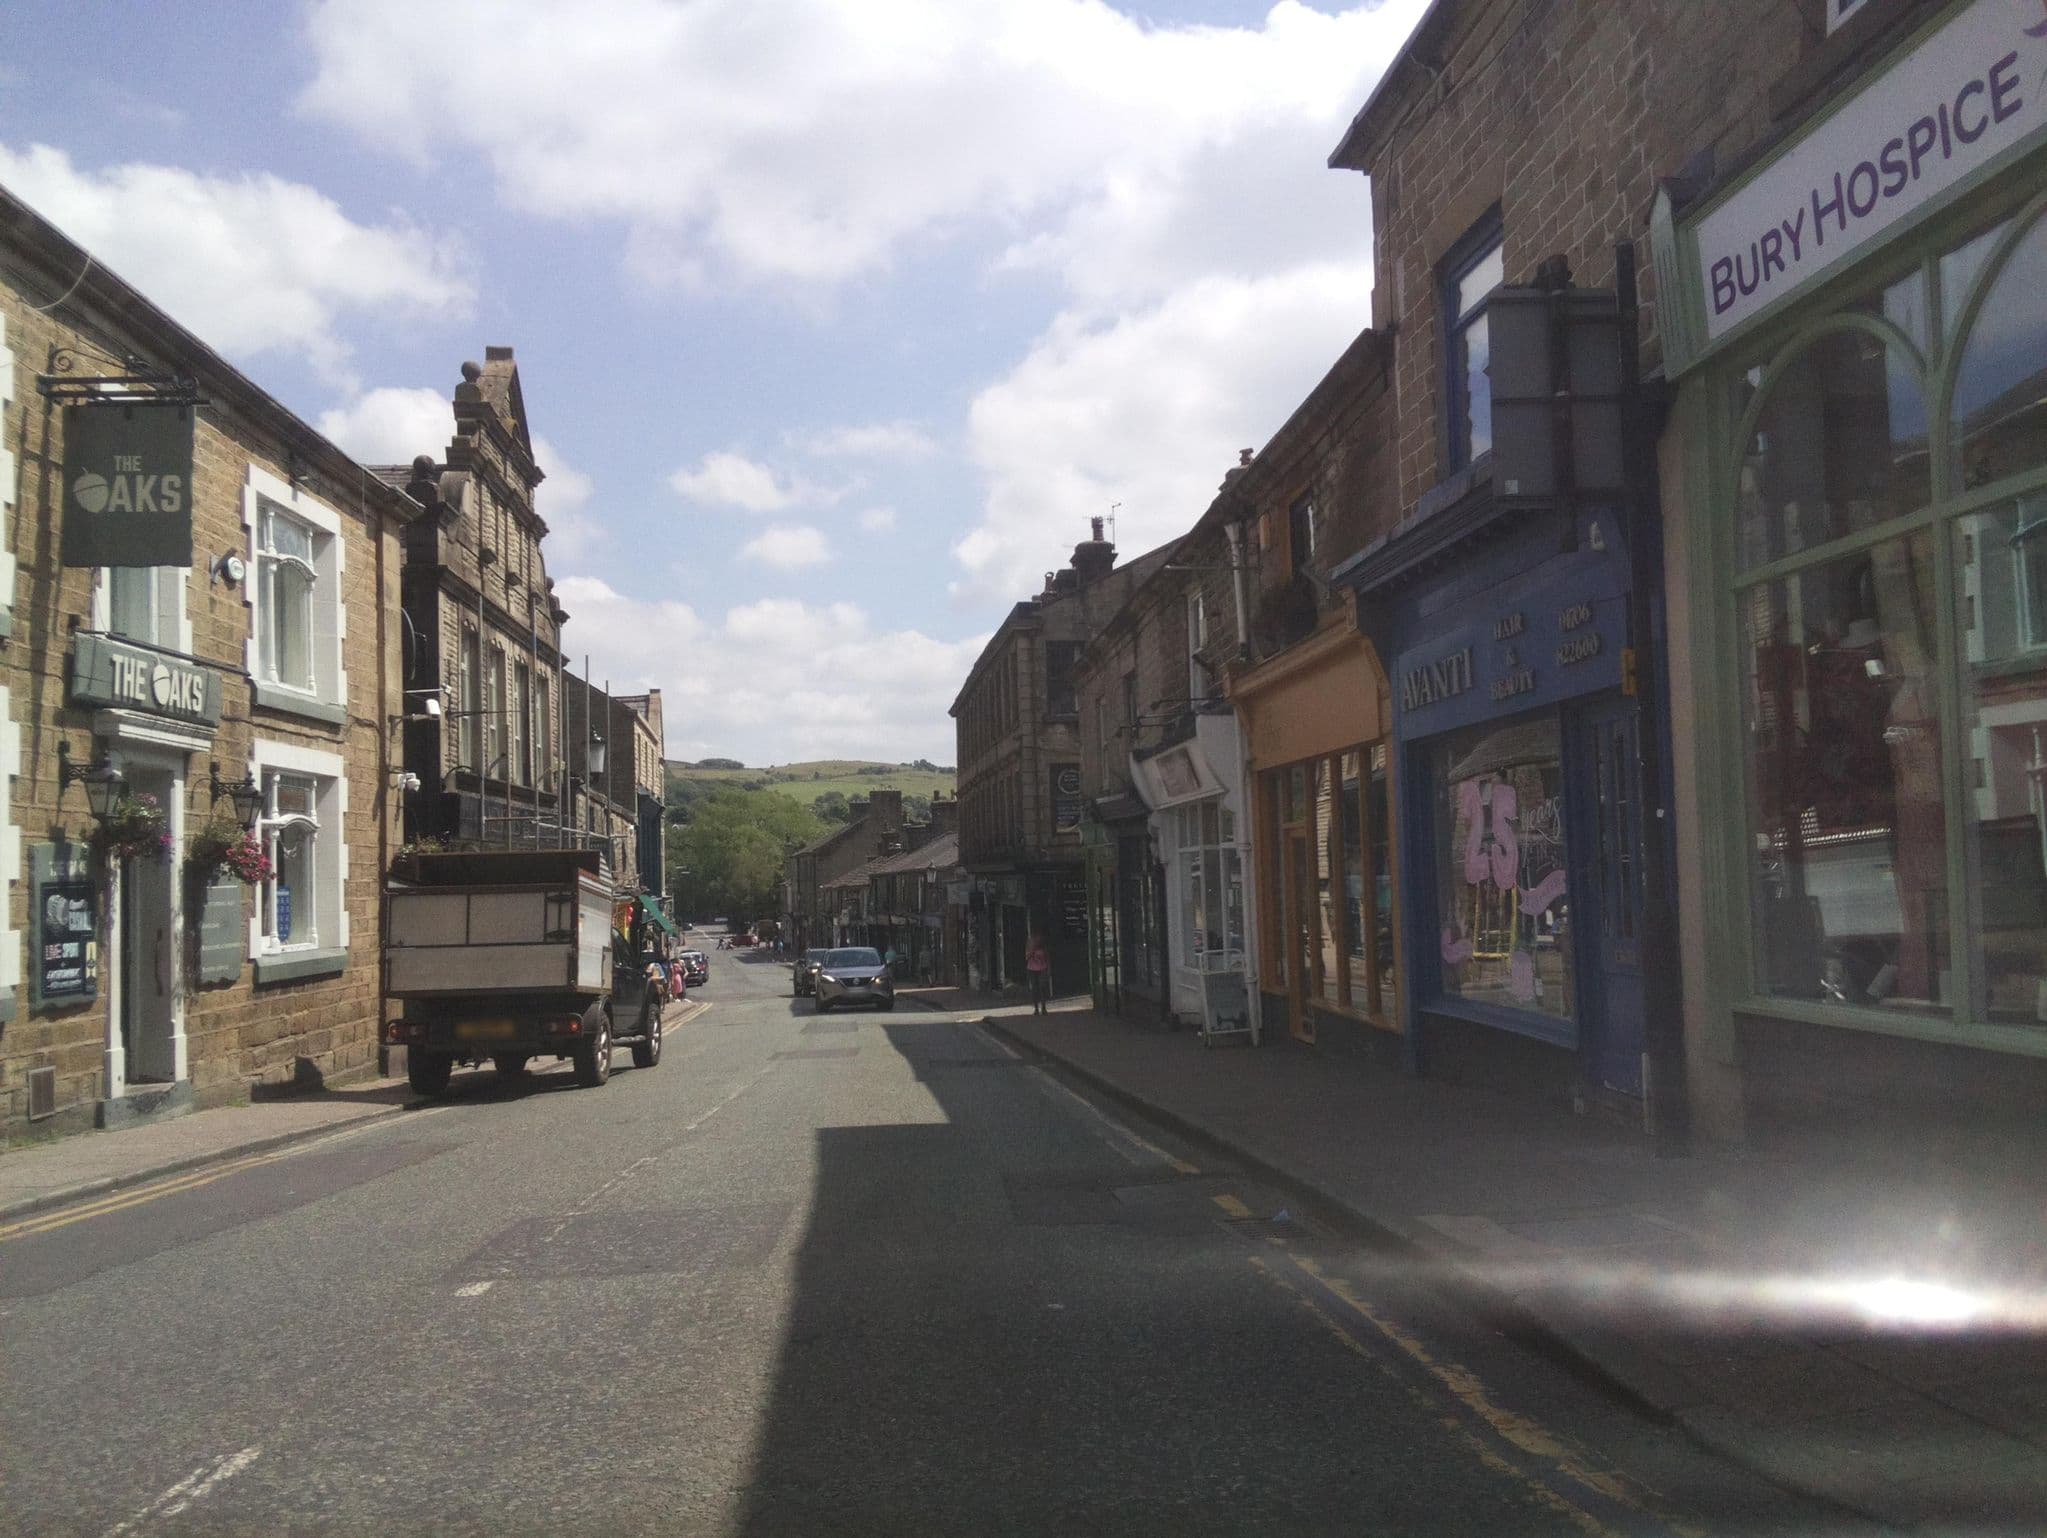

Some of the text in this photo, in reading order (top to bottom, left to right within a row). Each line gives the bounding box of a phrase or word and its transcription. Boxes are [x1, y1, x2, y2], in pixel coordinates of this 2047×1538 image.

[1710, 50, 2024, 315] BURY HOSPICE
[114, 455, 141, 471] THE
[111, 653, 147, 702] THE
[1401, 647, 1473, 711] AVANTI
